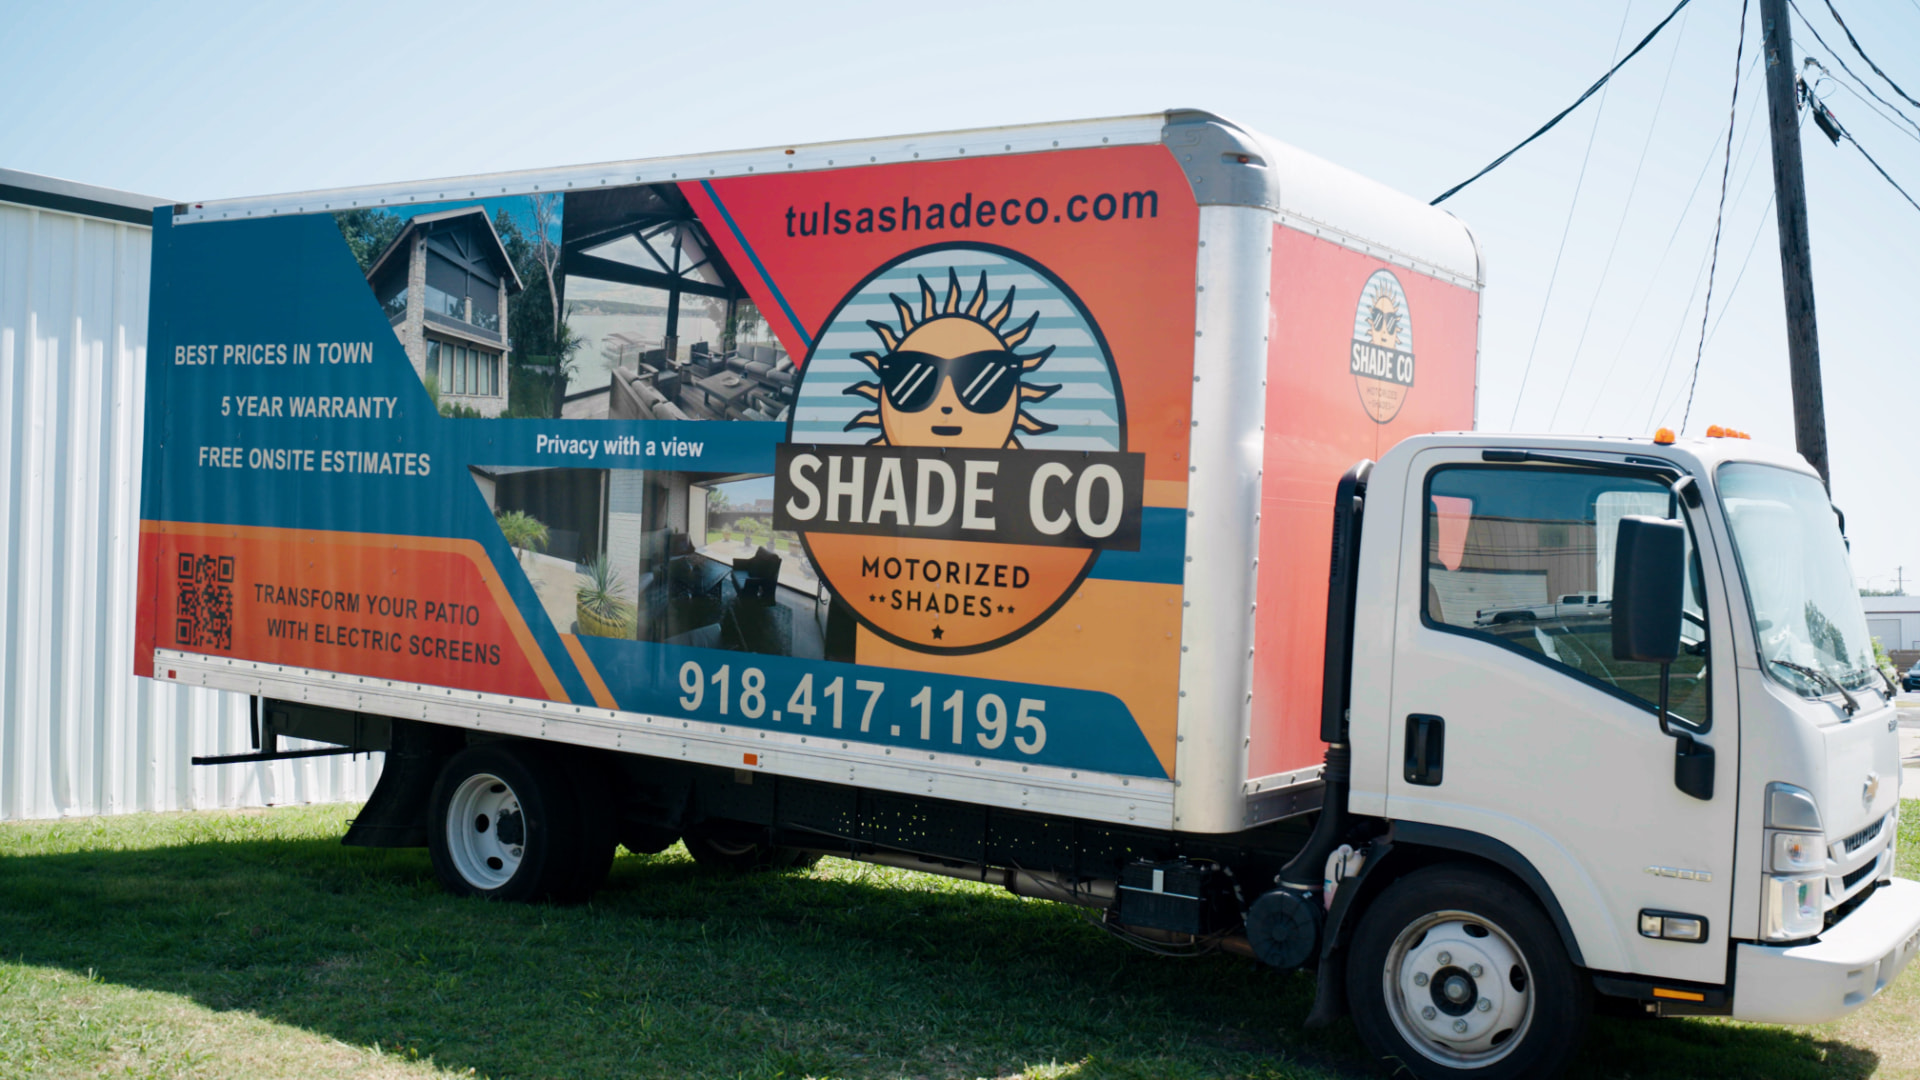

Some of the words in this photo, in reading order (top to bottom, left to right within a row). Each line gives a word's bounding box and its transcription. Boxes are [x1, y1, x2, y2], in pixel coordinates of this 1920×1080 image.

[785, 189, 1159, 238] tulsashadeco.com
[174, 345, 218, 366] BEST
[223, 344, 287, 365] PRICES
[293, 343, 311, 364] IN
[317, 342, 374, 364] TOWN
[1352, 343, 1394, 379] SHADE
[1396, 355, 1413, 384] CO
[221, 396, 231, 417] 5
[235, 396, 284, 417] YEAR
[289, 396, 398, 419] WARRANTY
[198, 446, 243, 468] FREE
[249, 448, 315, 471] ONSITE
[321, 450, 431, 476] ESTIMATES
[536, 434, 599, 460] Privacy
[603, 435, 640, 456] with
[645, 440, 656, 456] a
[661, 436, 704, 458] view
[785, 453, 1000, 531] SHADE
[1029, 462, 1124, 538] CO
[861, 555, 1030, 589] MOTORIZED
[254, 583, 360, 613] TRANSFORM
[366, 594, 418, 620] YOUR
[424, 600, 480, 627] PATIO
[891, 589, 992, 618] SHADES
[267, 618, 309, 641] WITH
[314, 623, 402, 653] ELECTRIC
[408, 635, 501, 666] SCREENS
[678, 661, 1047, 755] 918.417.1195
